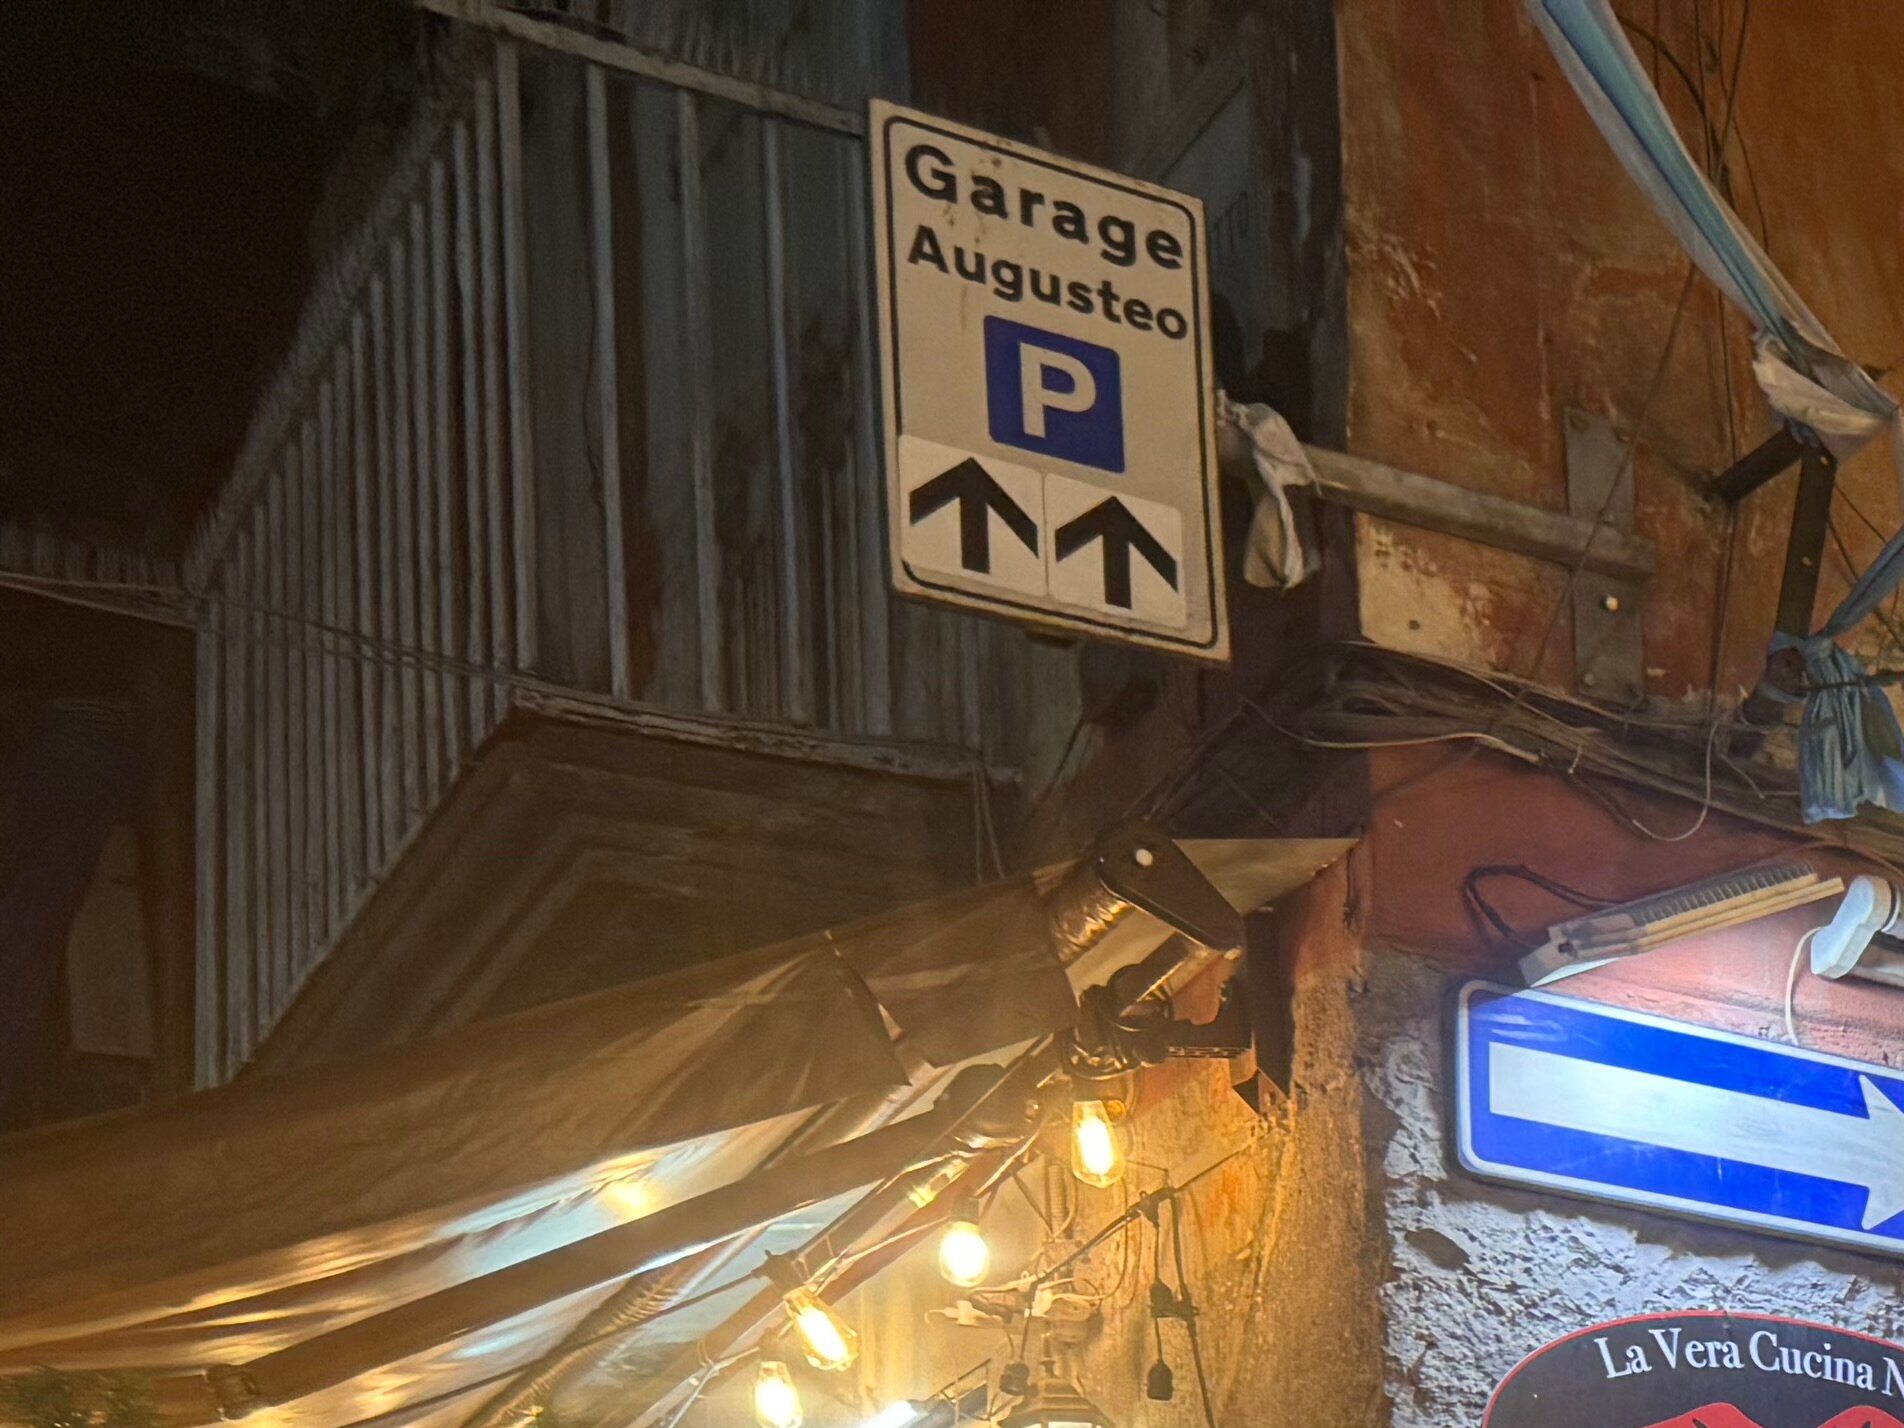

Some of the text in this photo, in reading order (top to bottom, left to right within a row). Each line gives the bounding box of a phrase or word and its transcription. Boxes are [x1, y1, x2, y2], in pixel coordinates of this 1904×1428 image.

[904, 143, 1184, 270] Garage
[908, 225, 1189, 341] Augusteo
[1018, 341, 1097, 440] P
[1594, 1337, 1653, 1379] La
[1648, 1328, 1745, 1369] Vera
[1749, 1330, 1877, 1391] Cucina
